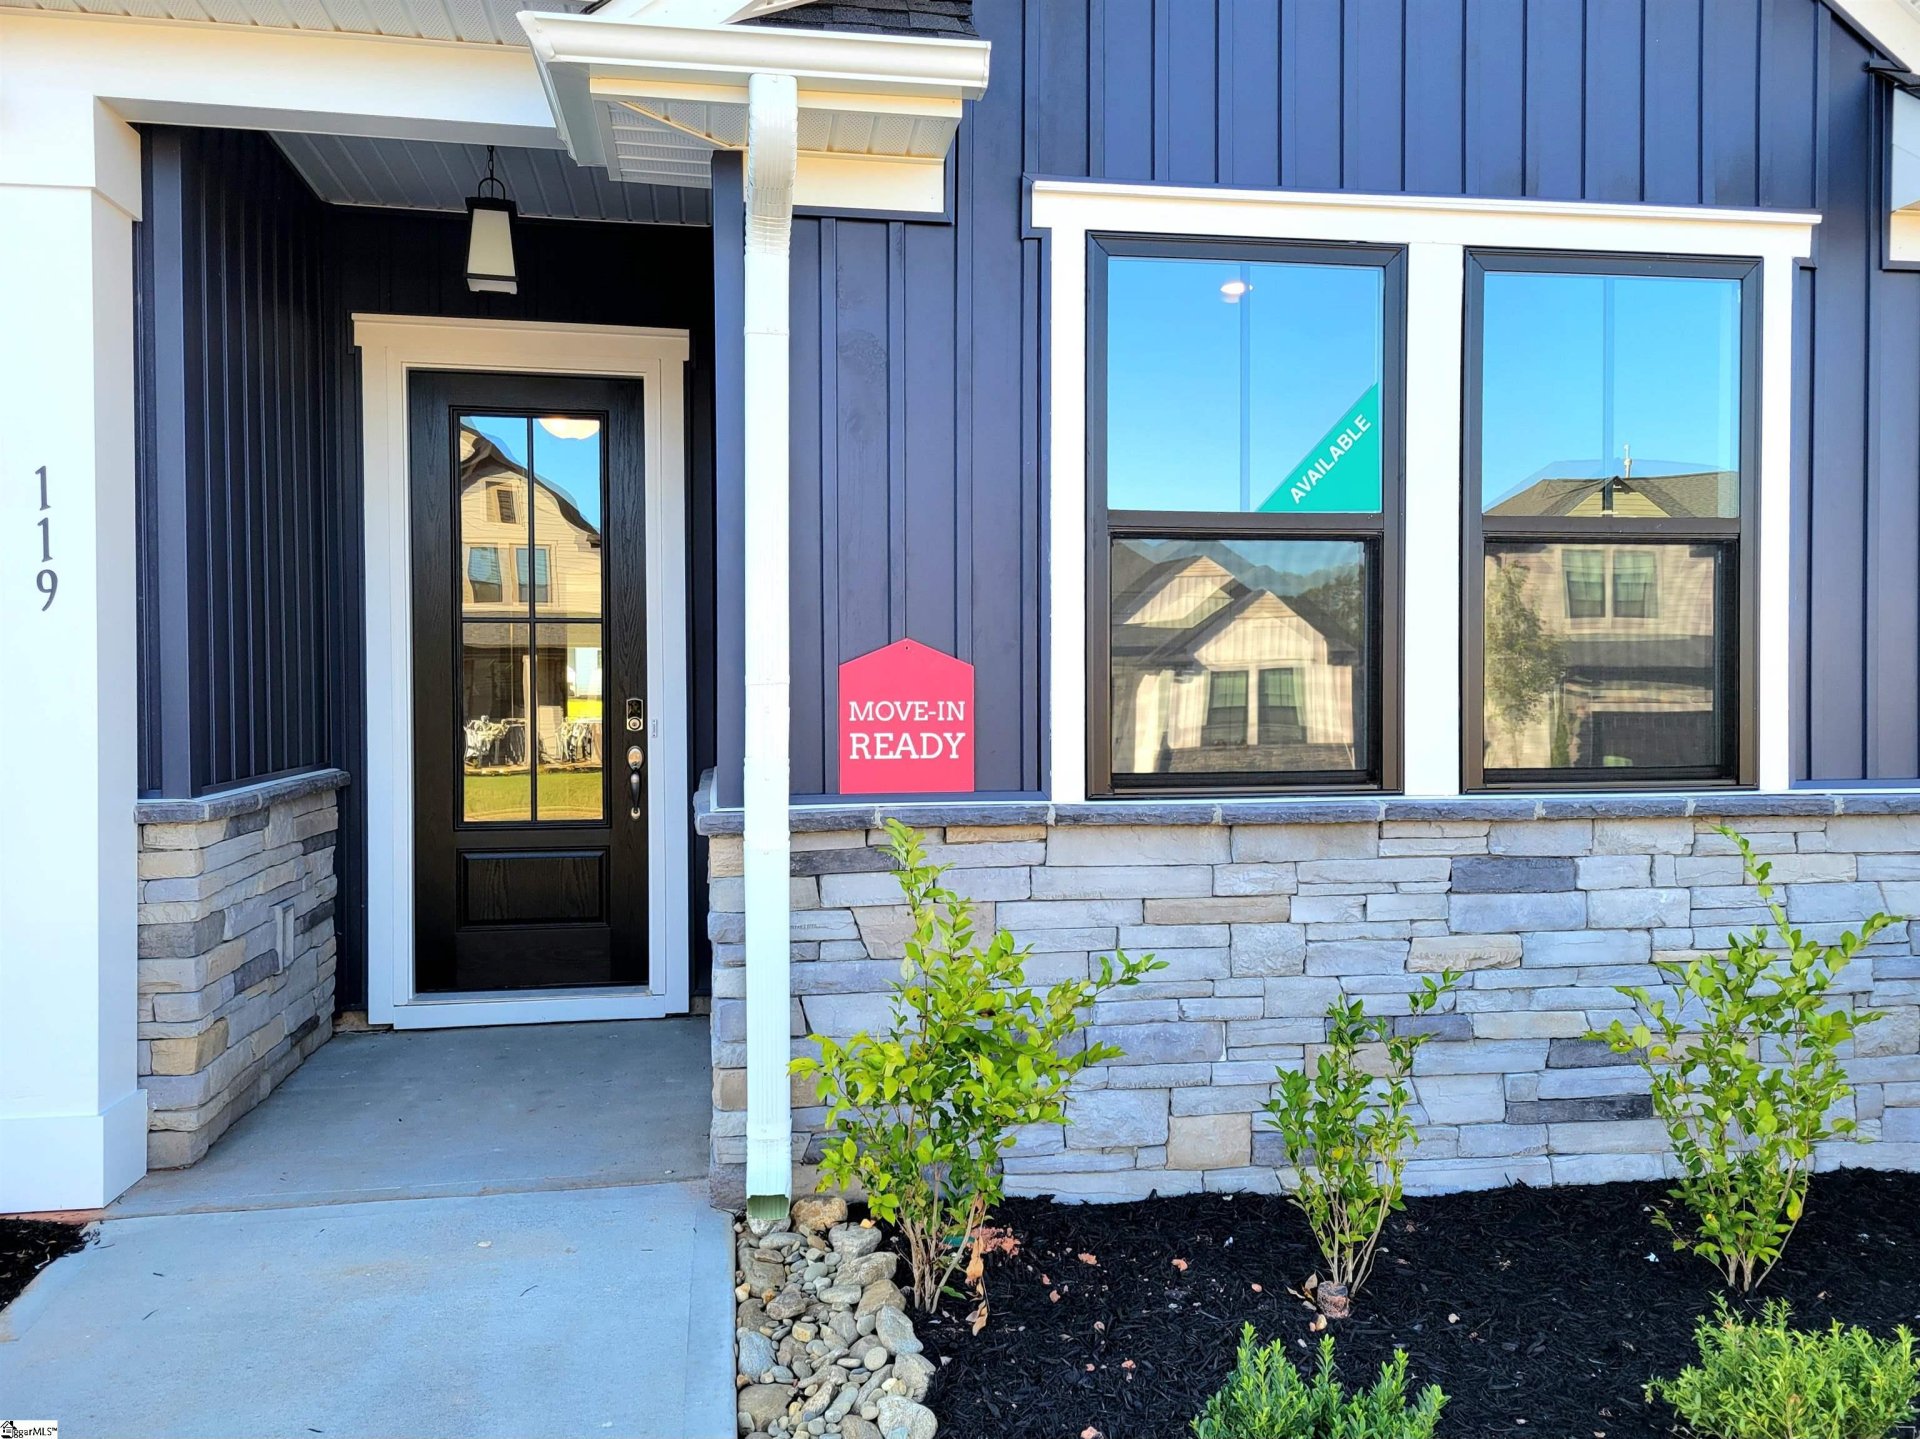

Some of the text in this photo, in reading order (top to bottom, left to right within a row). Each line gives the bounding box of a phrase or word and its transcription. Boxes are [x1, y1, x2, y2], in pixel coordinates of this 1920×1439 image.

[1290, 414, 1372, 504] AVAILABLE
[848, 700, 966, 722] MOVE-IN
[849, 732, 966, 760] READY
